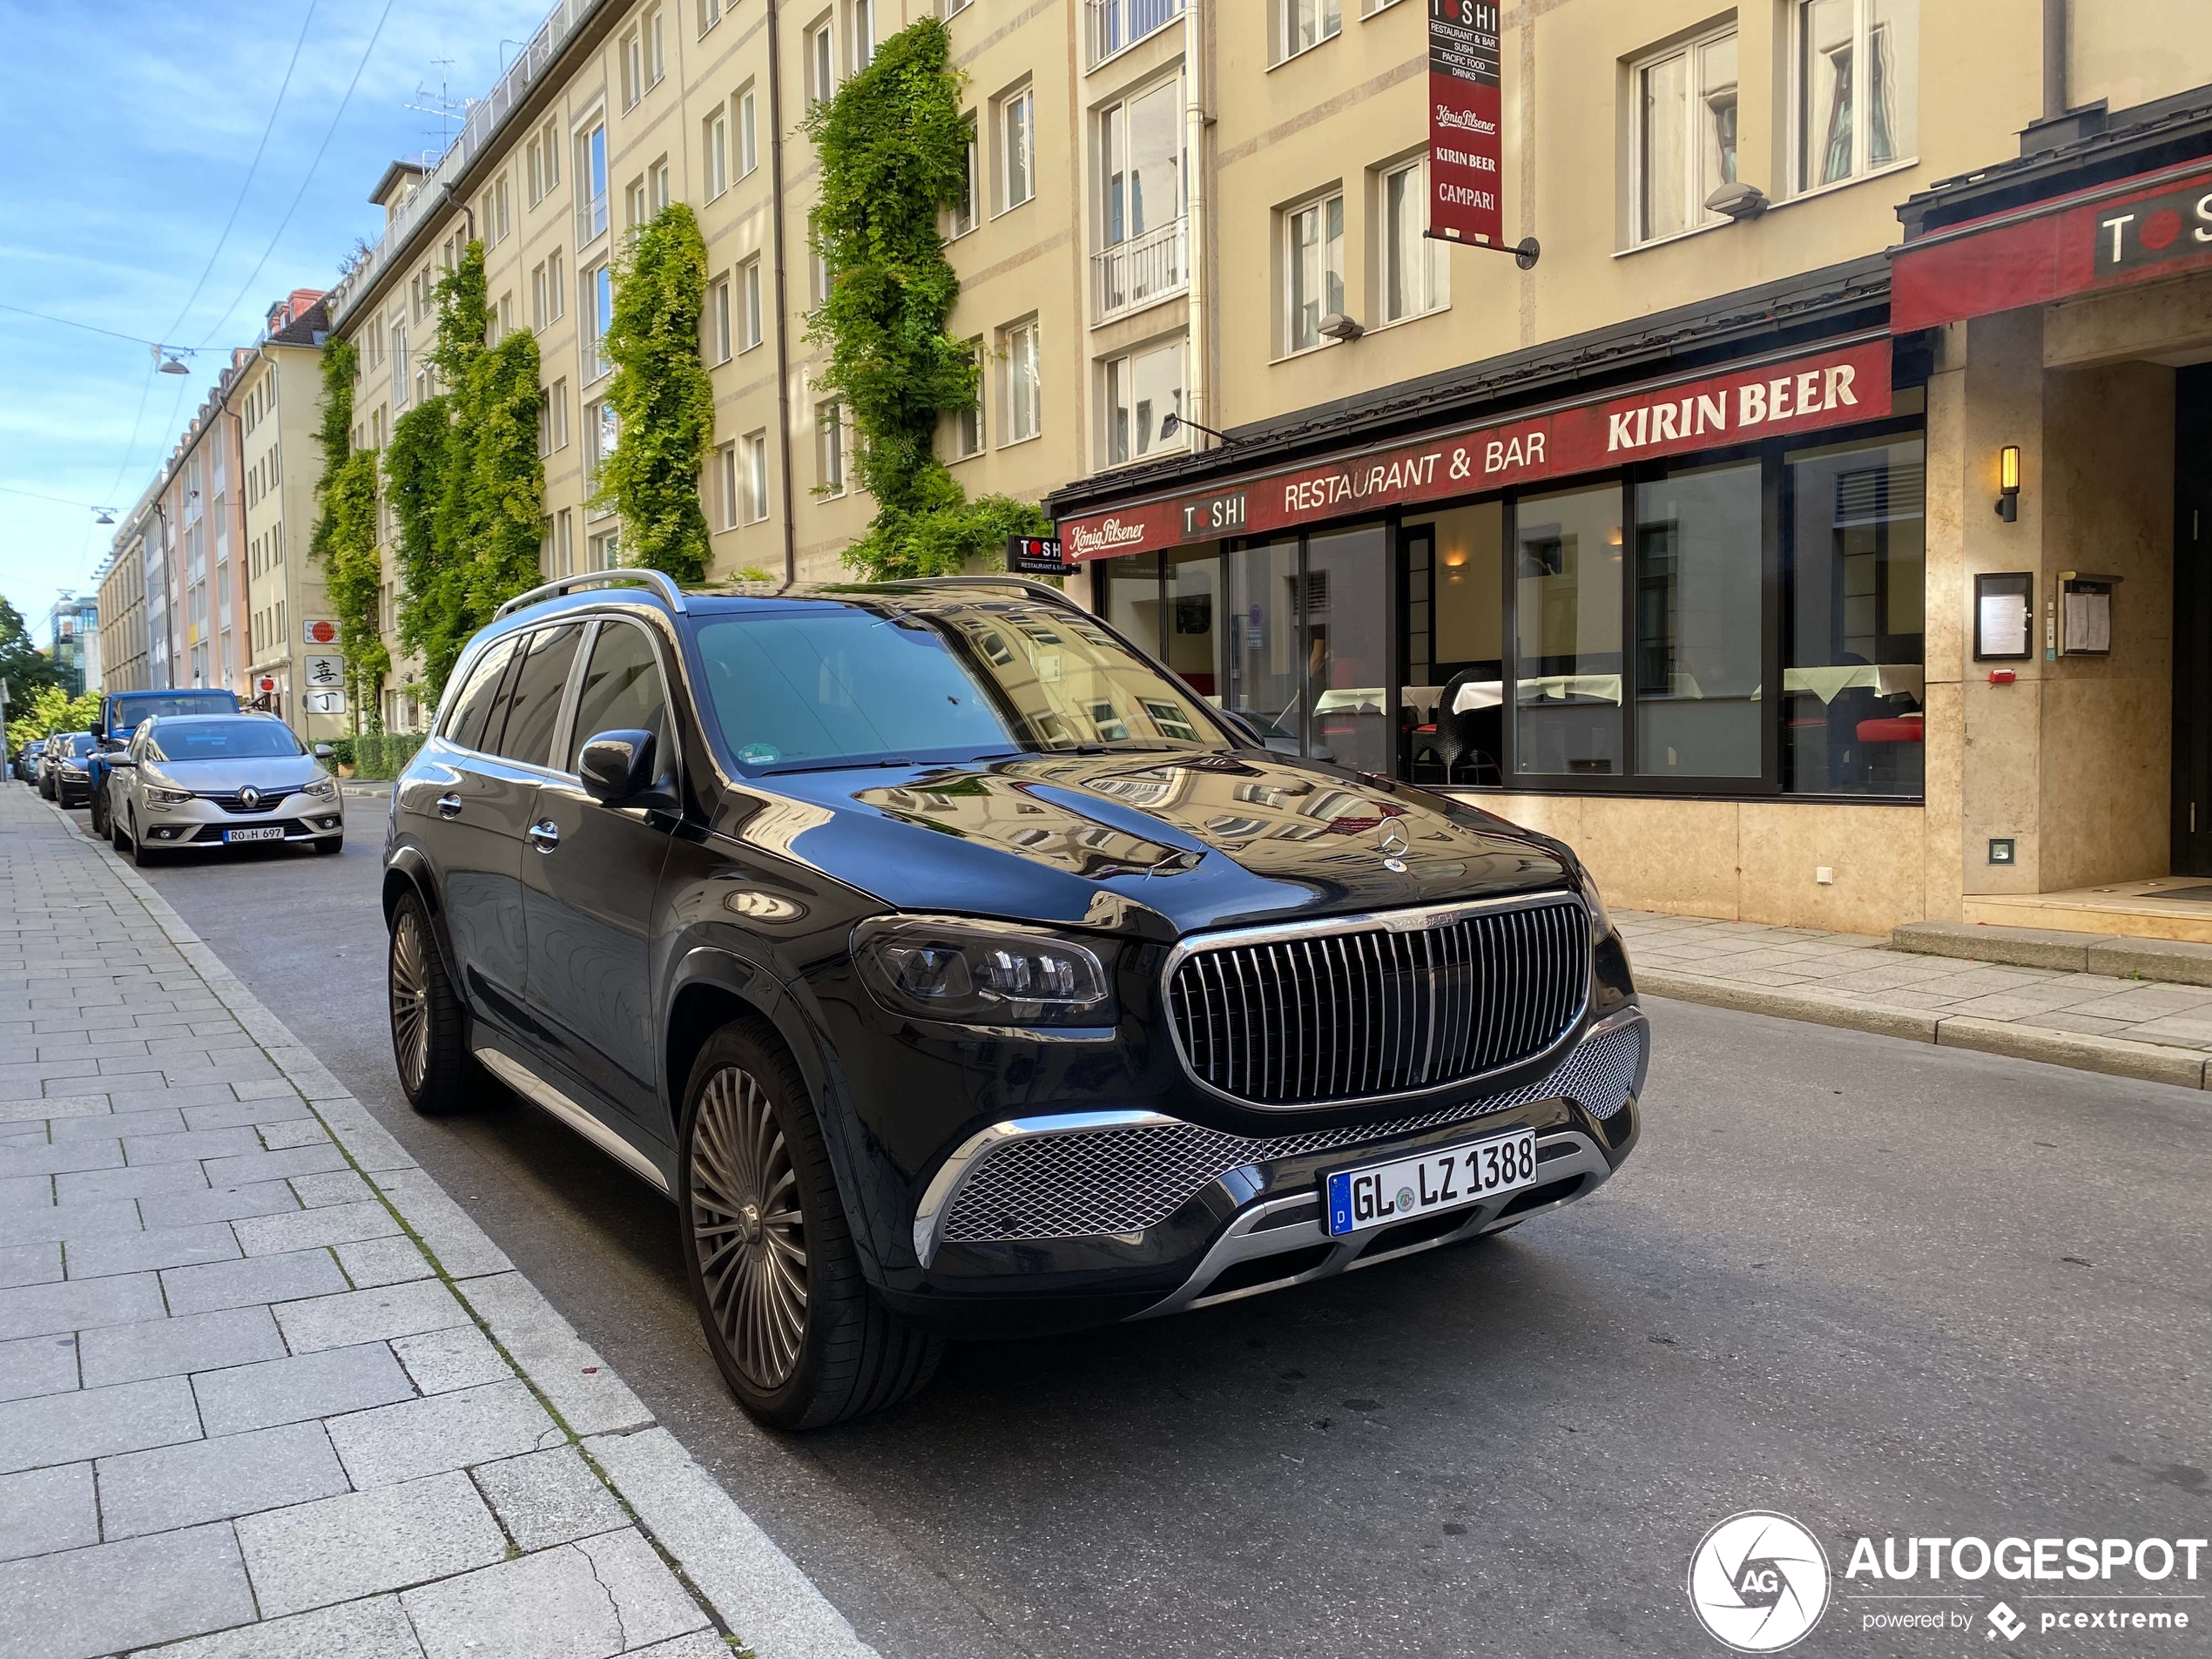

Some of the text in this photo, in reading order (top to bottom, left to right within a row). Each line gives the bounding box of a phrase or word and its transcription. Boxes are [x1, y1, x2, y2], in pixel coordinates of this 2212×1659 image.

[1431, 22, 1496, 48] RESTAURANT & BAR
[1454, 42, 1474, 55] SUSHI
[1442, 51, 1486, 71] PACIFIC FOOD
[1452, 67, 1476, 81] DRINKS
[1436, 146, 1496, 172] KIRIN BEER
[1439, 182, 1494, 211] CAMPARI
[1607, 364, 1859, 452] KIRIN BEER
[1285, 432, 1547, 513] RESTAURANT & BAR
[1021, 562, 1052, 570] RESTAURANT
[312, 659, 338, 683] 喜
[314, 691, 338, 711] 丁
[231, 828, 281, 840] RO H 697
[1353, 1137, 1534, 1221] GL LZ 1388
[1337, 1210, 1345, 1224] D
